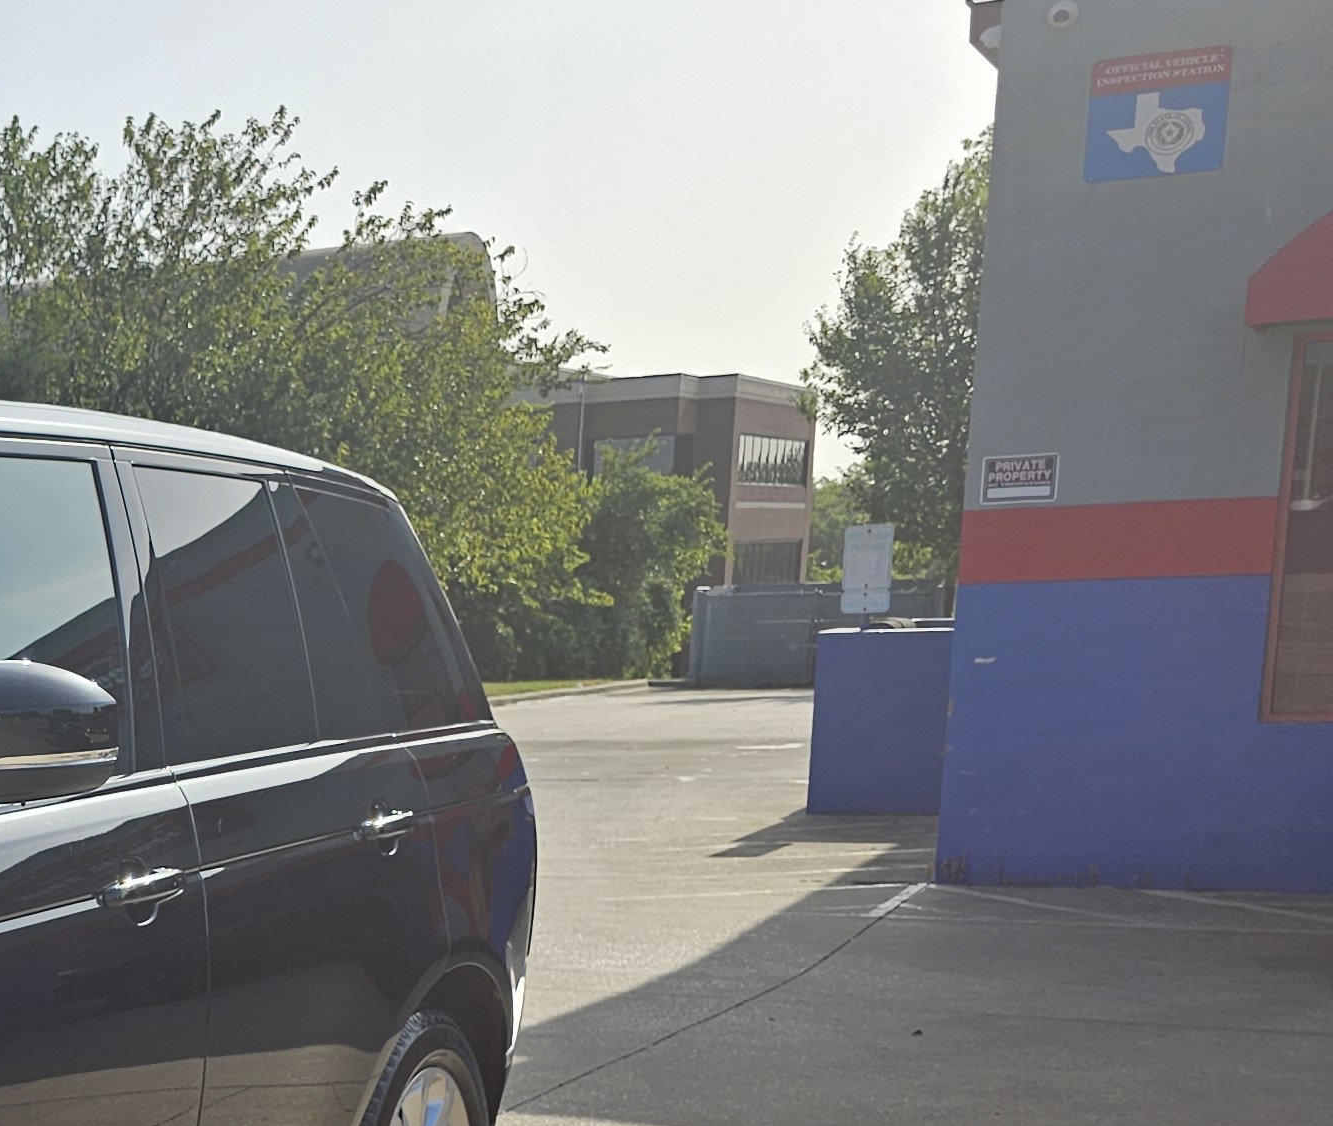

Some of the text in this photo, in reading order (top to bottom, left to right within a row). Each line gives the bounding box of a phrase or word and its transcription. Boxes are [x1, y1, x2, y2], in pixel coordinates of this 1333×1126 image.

[1105, 53, 1218, 75] OFFICIAL VEHICLE
[1096, 63, 1226, 88] INSPECTION STATION
[994, 459, 1046, 472] PRIVATE
[987, 470, 1052, 483] PROPERTY
